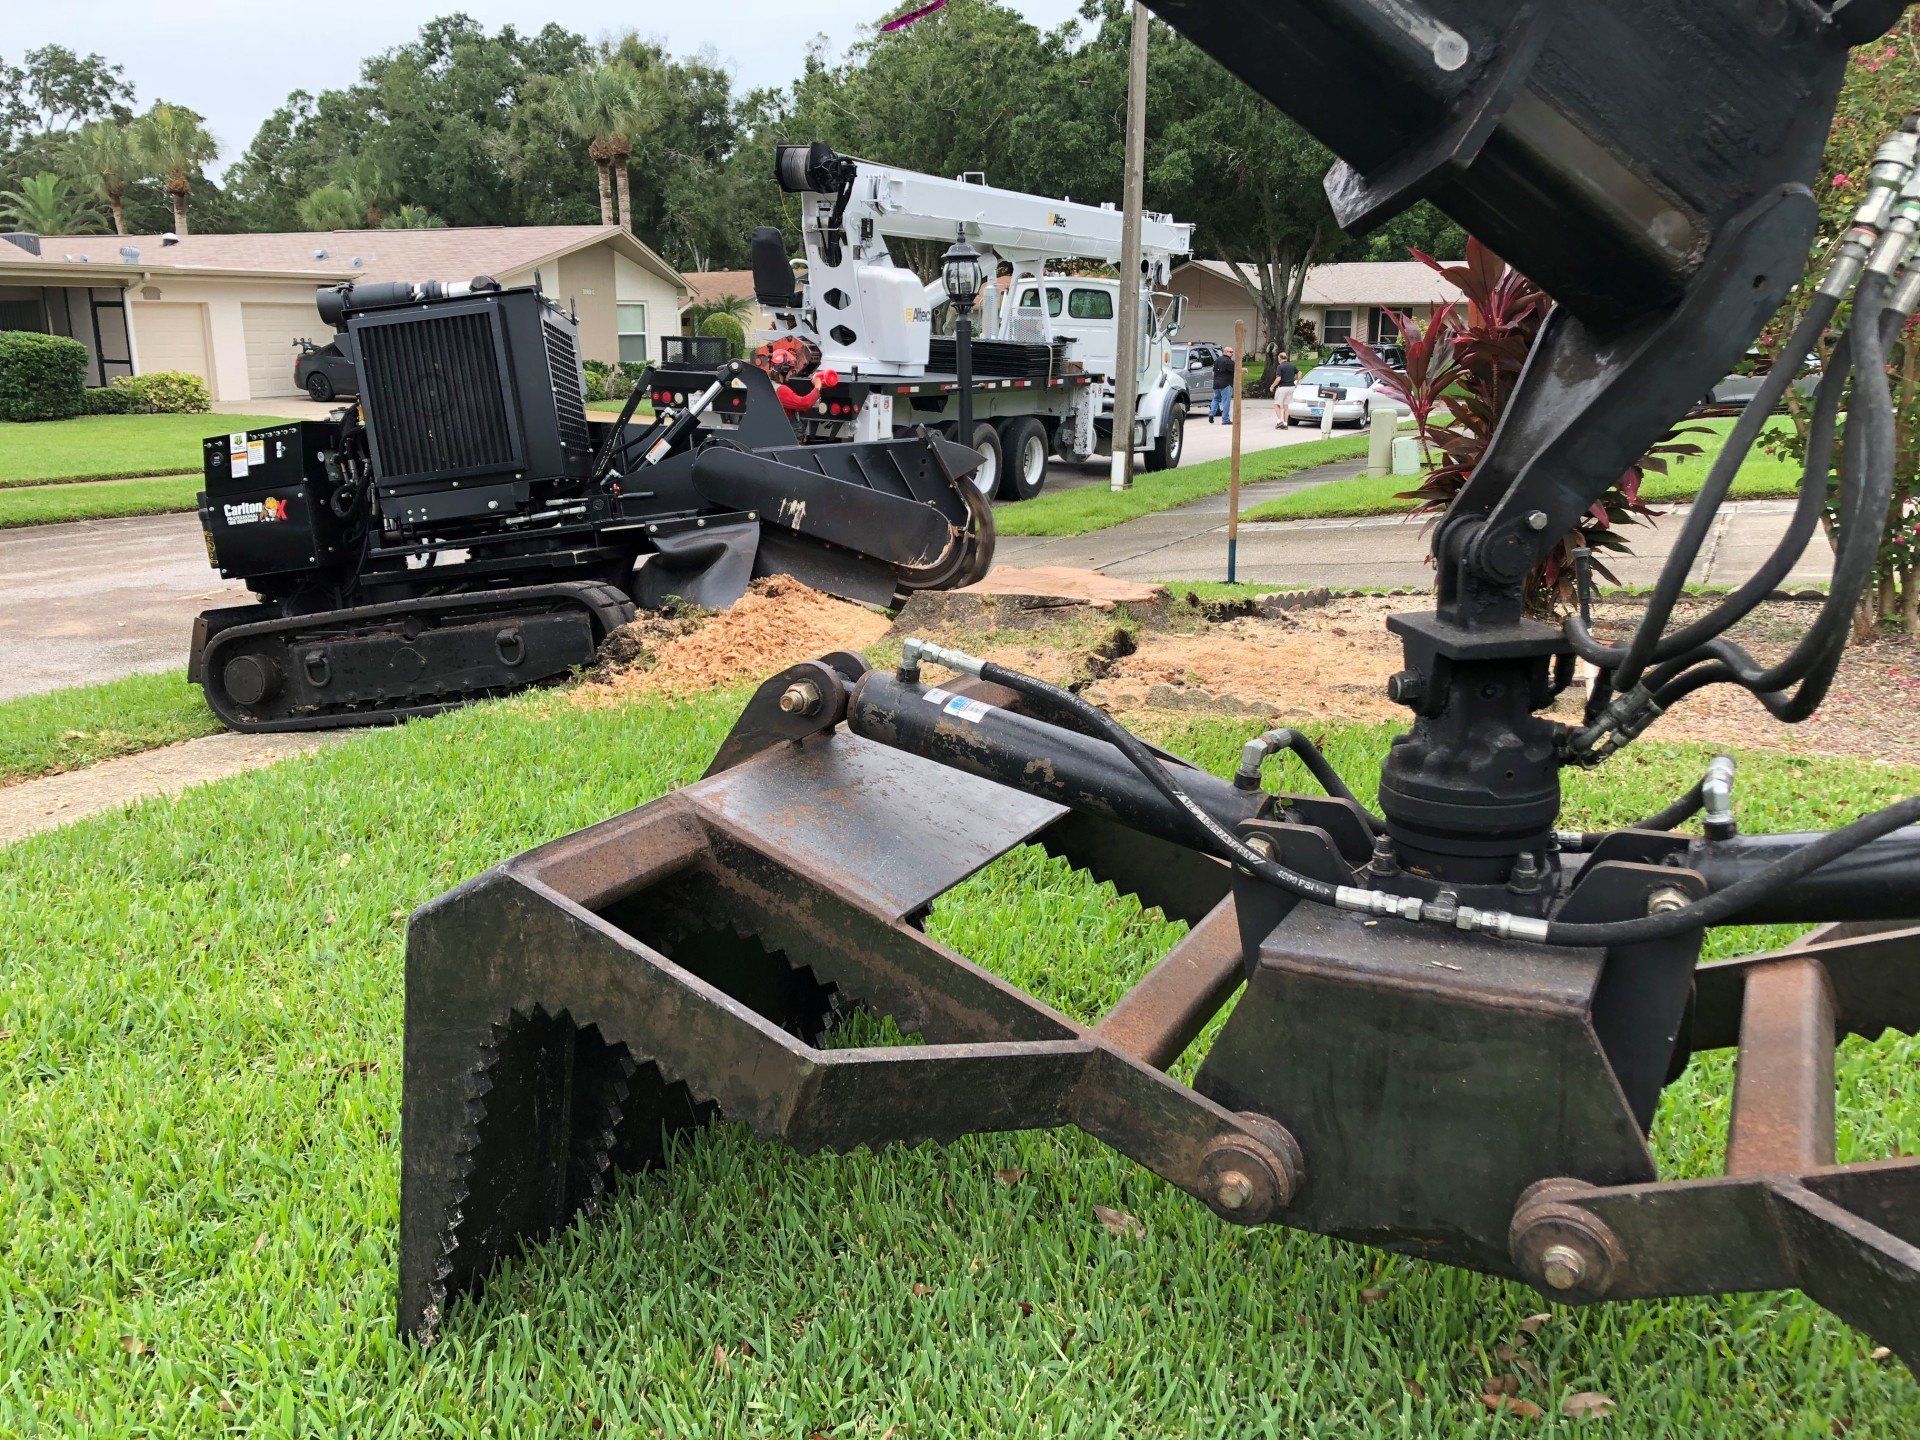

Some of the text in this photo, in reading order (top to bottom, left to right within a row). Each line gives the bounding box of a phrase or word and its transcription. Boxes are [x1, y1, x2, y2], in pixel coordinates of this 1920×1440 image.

[912, 307, 931, 322] Altec
[223, 502, 263, 517] Carlton
[1016, 675, 1055, 692] RESISTANT
[1298, 878, 1315, 891] PSI
